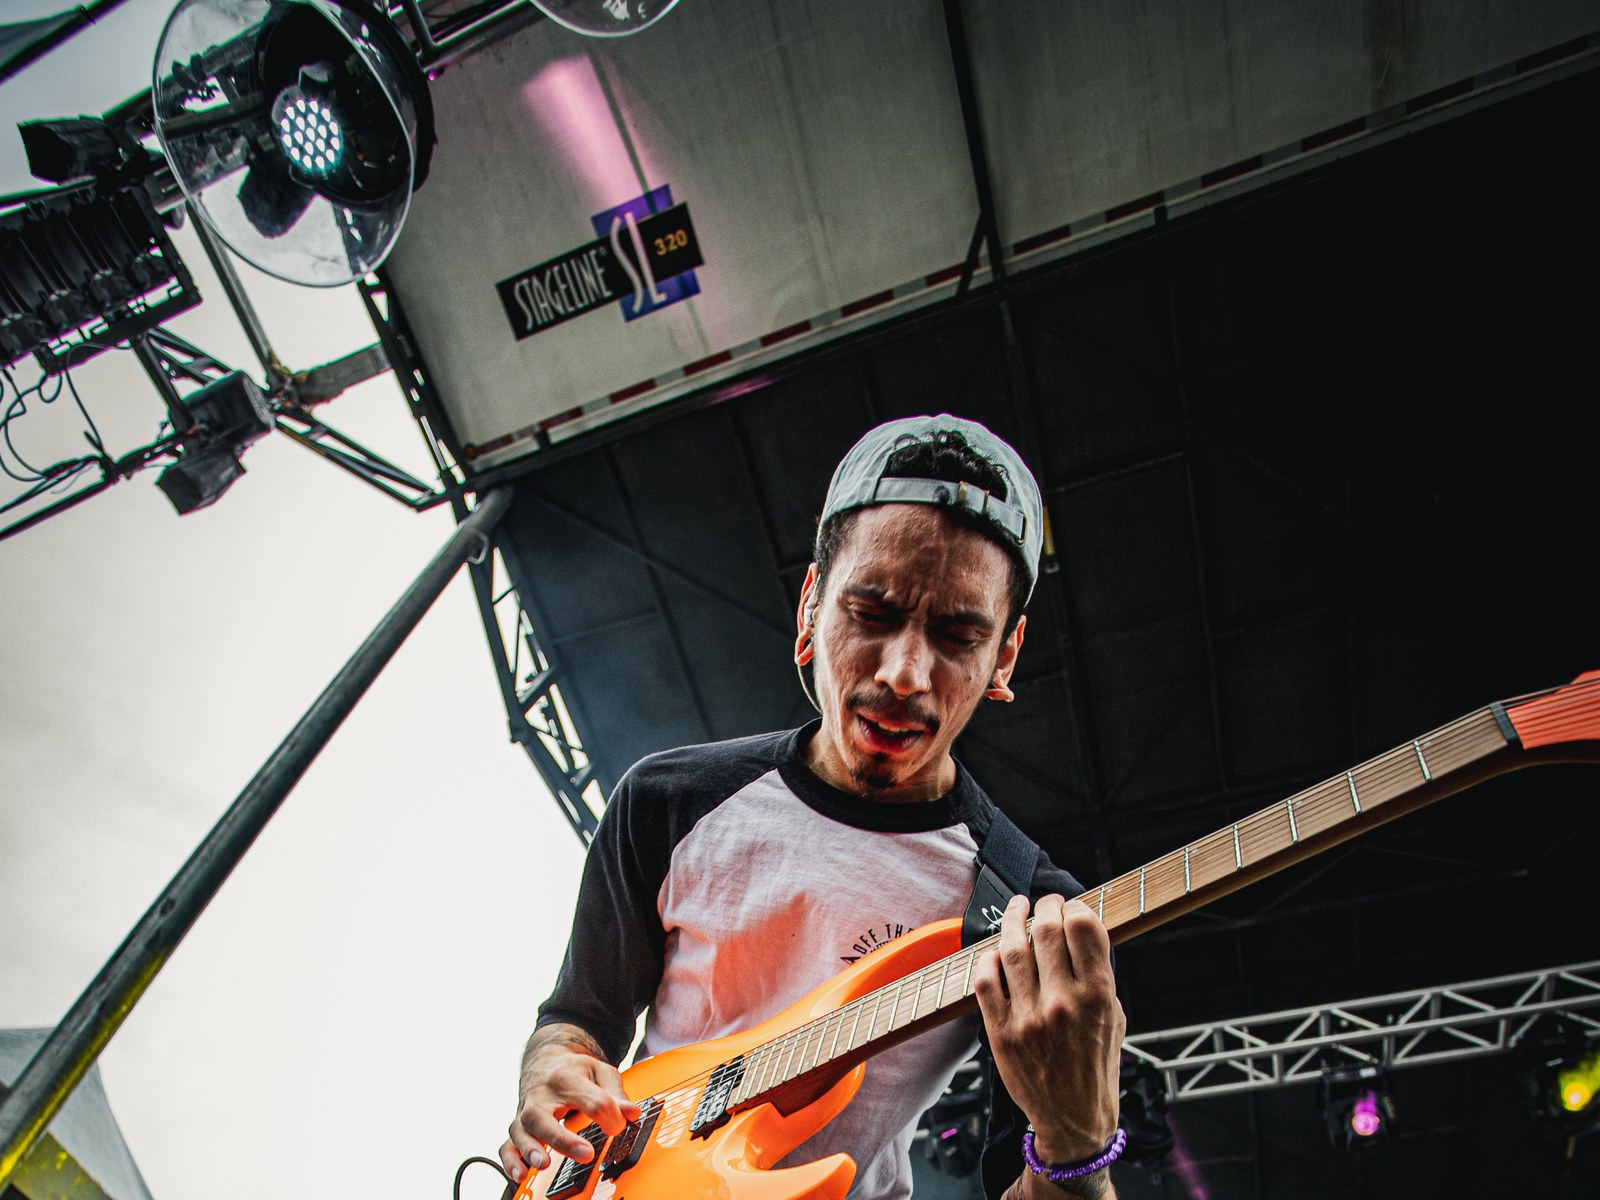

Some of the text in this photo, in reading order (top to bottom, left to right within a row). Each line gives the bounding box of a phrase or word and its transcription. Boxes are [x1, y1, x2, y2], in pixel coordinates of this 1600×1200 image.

[513, 211, 689, 331] STAGELINE SL 320
[853, 928, 878, 955] OFF
